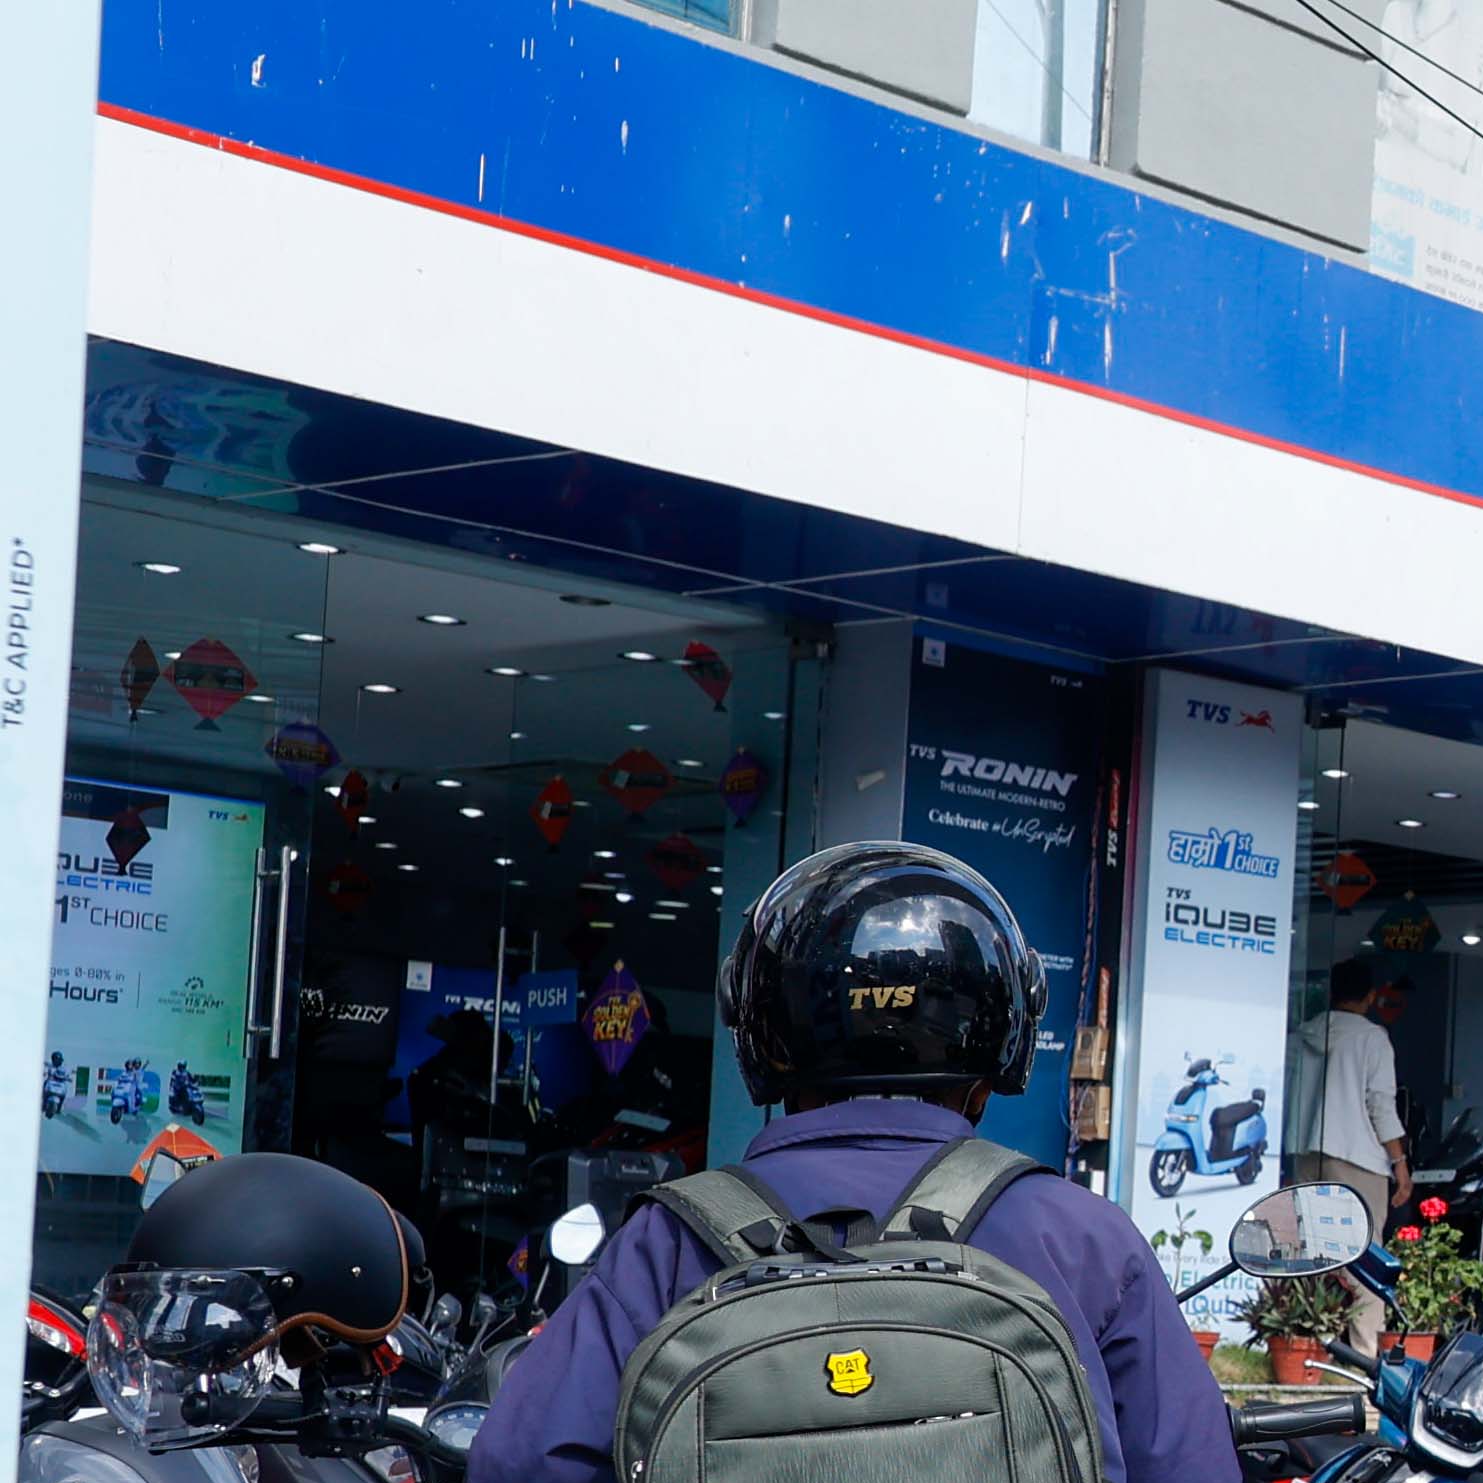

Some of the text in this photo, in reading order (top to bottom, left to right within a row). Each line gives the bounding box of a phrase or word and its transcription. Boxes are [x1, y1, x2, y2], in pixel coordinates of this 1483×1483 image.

[1, 677, 27, 730] T&C
[1187, 699, 1232, 725] TVS
[909, 743, 1079, 798] TVS RONIN
[207, 808, 230, 821] TVS
[928, 808, 989, 832] Celebrate
[1235, 852, 1279, 877] CHOICE
[1166, 886, 1192, 901] TVS
[90, 905, 169, 933] CHOICE
[1164, 926, 1276, 955] ELECTRIC
[527, 986, 568, 1009] PUSH
[848, 984, 917, 1011] TVS
[835, 1358, 860, 1376] CAT
